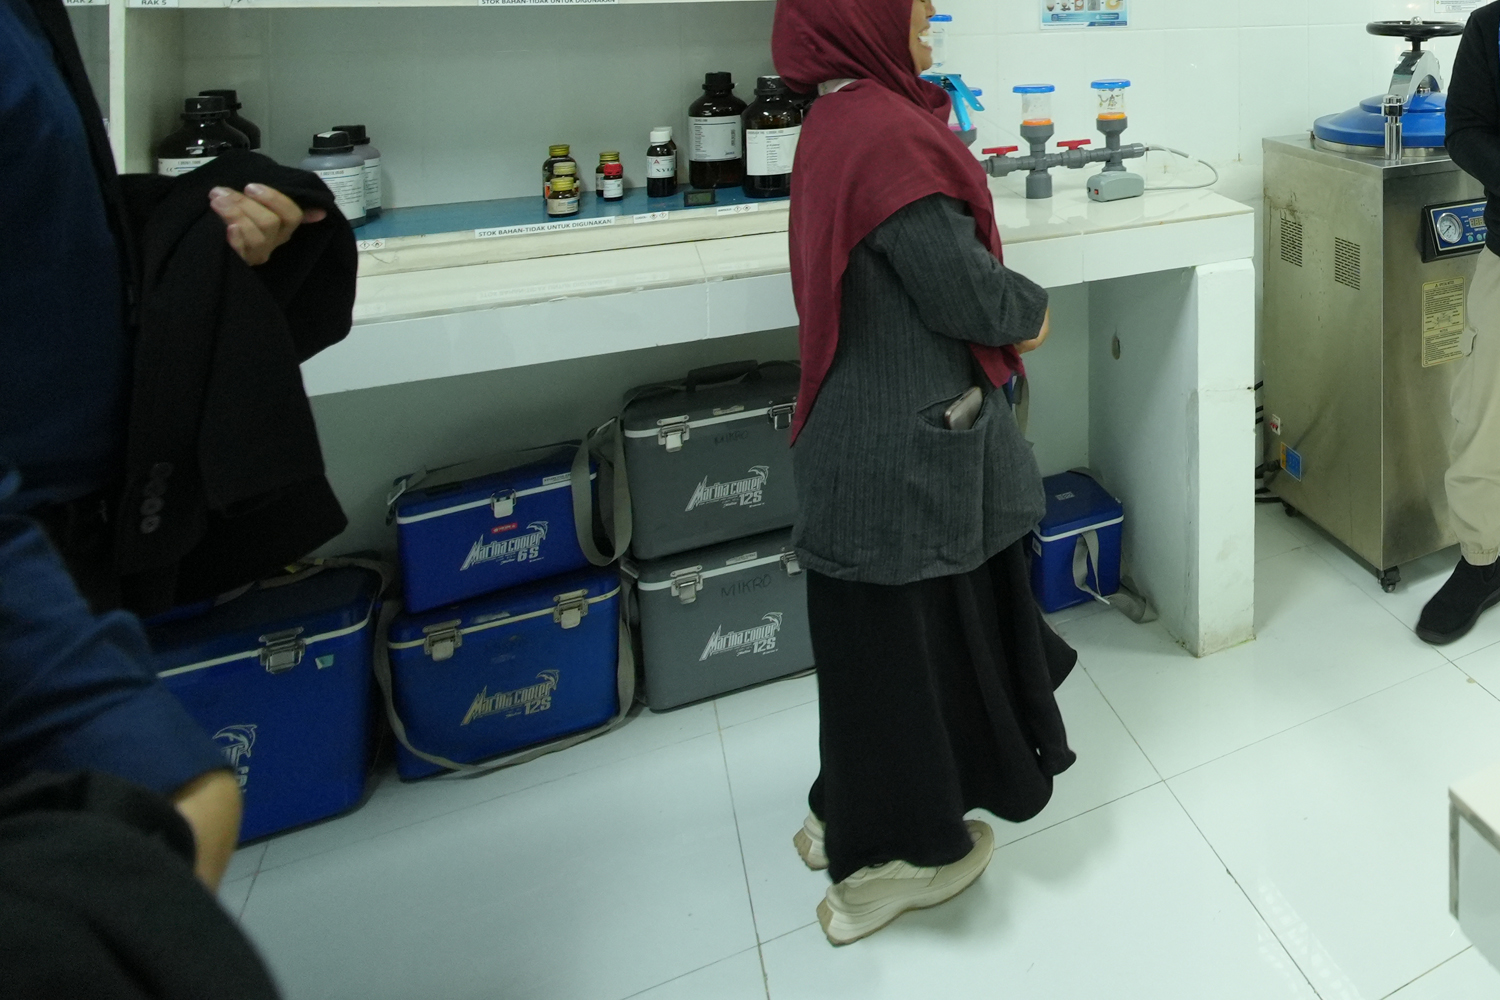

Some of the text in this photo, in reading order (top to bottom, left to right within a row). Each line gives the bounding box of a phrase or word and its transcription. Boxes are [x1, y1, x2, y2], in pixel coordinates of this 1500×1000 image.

[478, 218, 612, 238] STOK BAHAN-TIDAK UNTUK DIGUNAKAN
[739, 490, 763, 506] 12S
[721, 573, 772, 598] MIKRO
[752, 637, 777, 654] 12S
[524, 695, 552, 716] 12S
